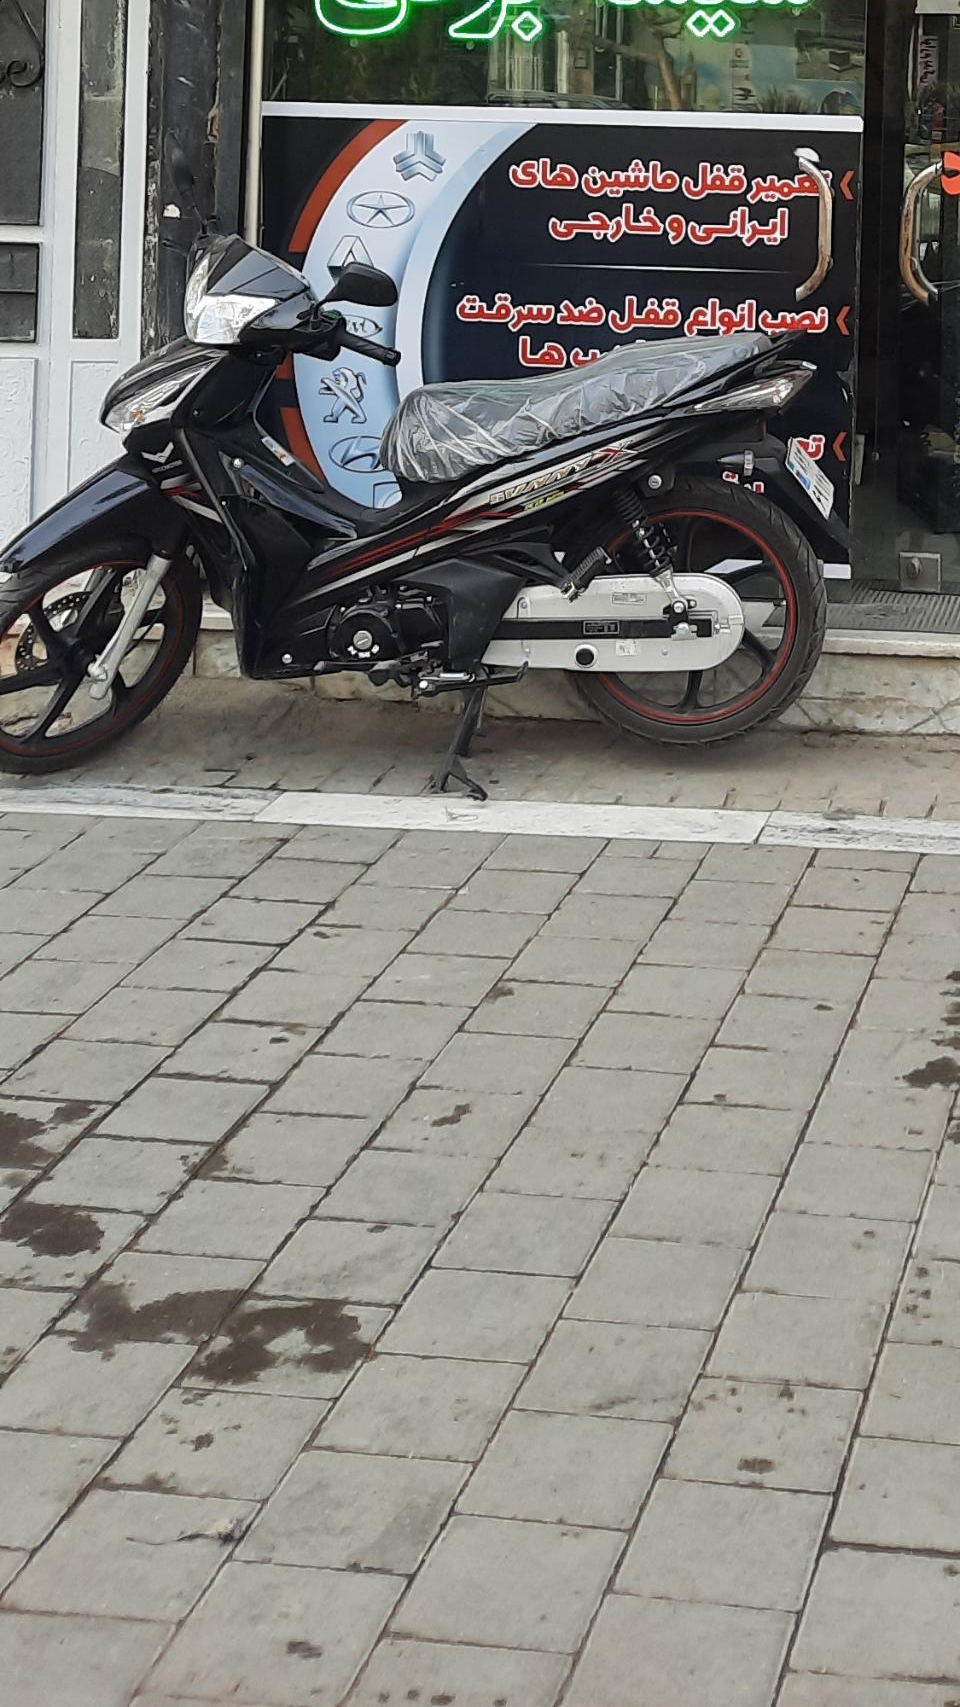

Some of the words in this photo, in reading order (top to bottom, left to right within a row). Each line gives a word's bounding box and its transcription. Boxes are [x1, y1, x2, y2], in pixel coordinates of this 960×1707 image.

[509, 160, 578, 191] های
[582, 159, 680, 197] ماشین
[683, 164, 747, 200] قفل
[548, 202, 663, 242] خارجی
[667, 212, 684, 242] و
[687, 205, 789, 246] ایرانی
[456, 293, 554, 332] سرقت
[556, 296, 605, 328] ضد
[608, 296, 681, 333] قفل
[685, 299, 757, 337] انواع
[758, 306, 830, 336] نصب
